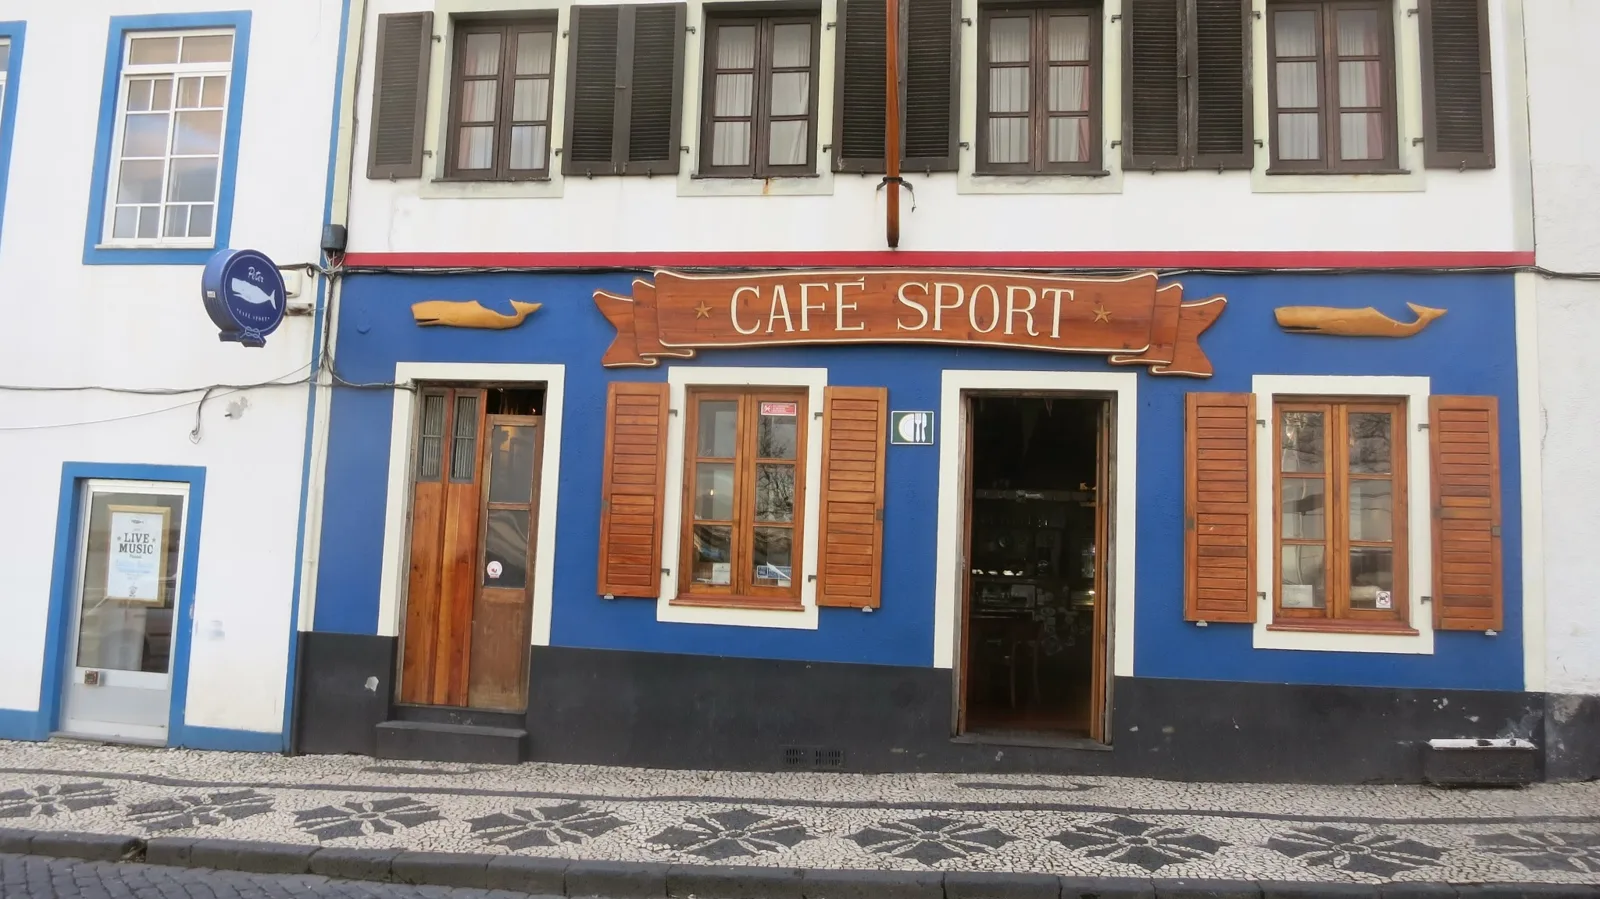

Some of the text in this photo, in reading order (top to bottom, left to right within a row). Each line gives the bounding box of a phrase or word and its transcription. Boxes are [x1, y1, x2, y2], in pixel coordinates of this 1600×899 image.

[730, 276, 1074, 338] CAFÉ SPORT
[124, 532, 150, 543] LIVE
[118, 543, 154, 554] MUSIC
